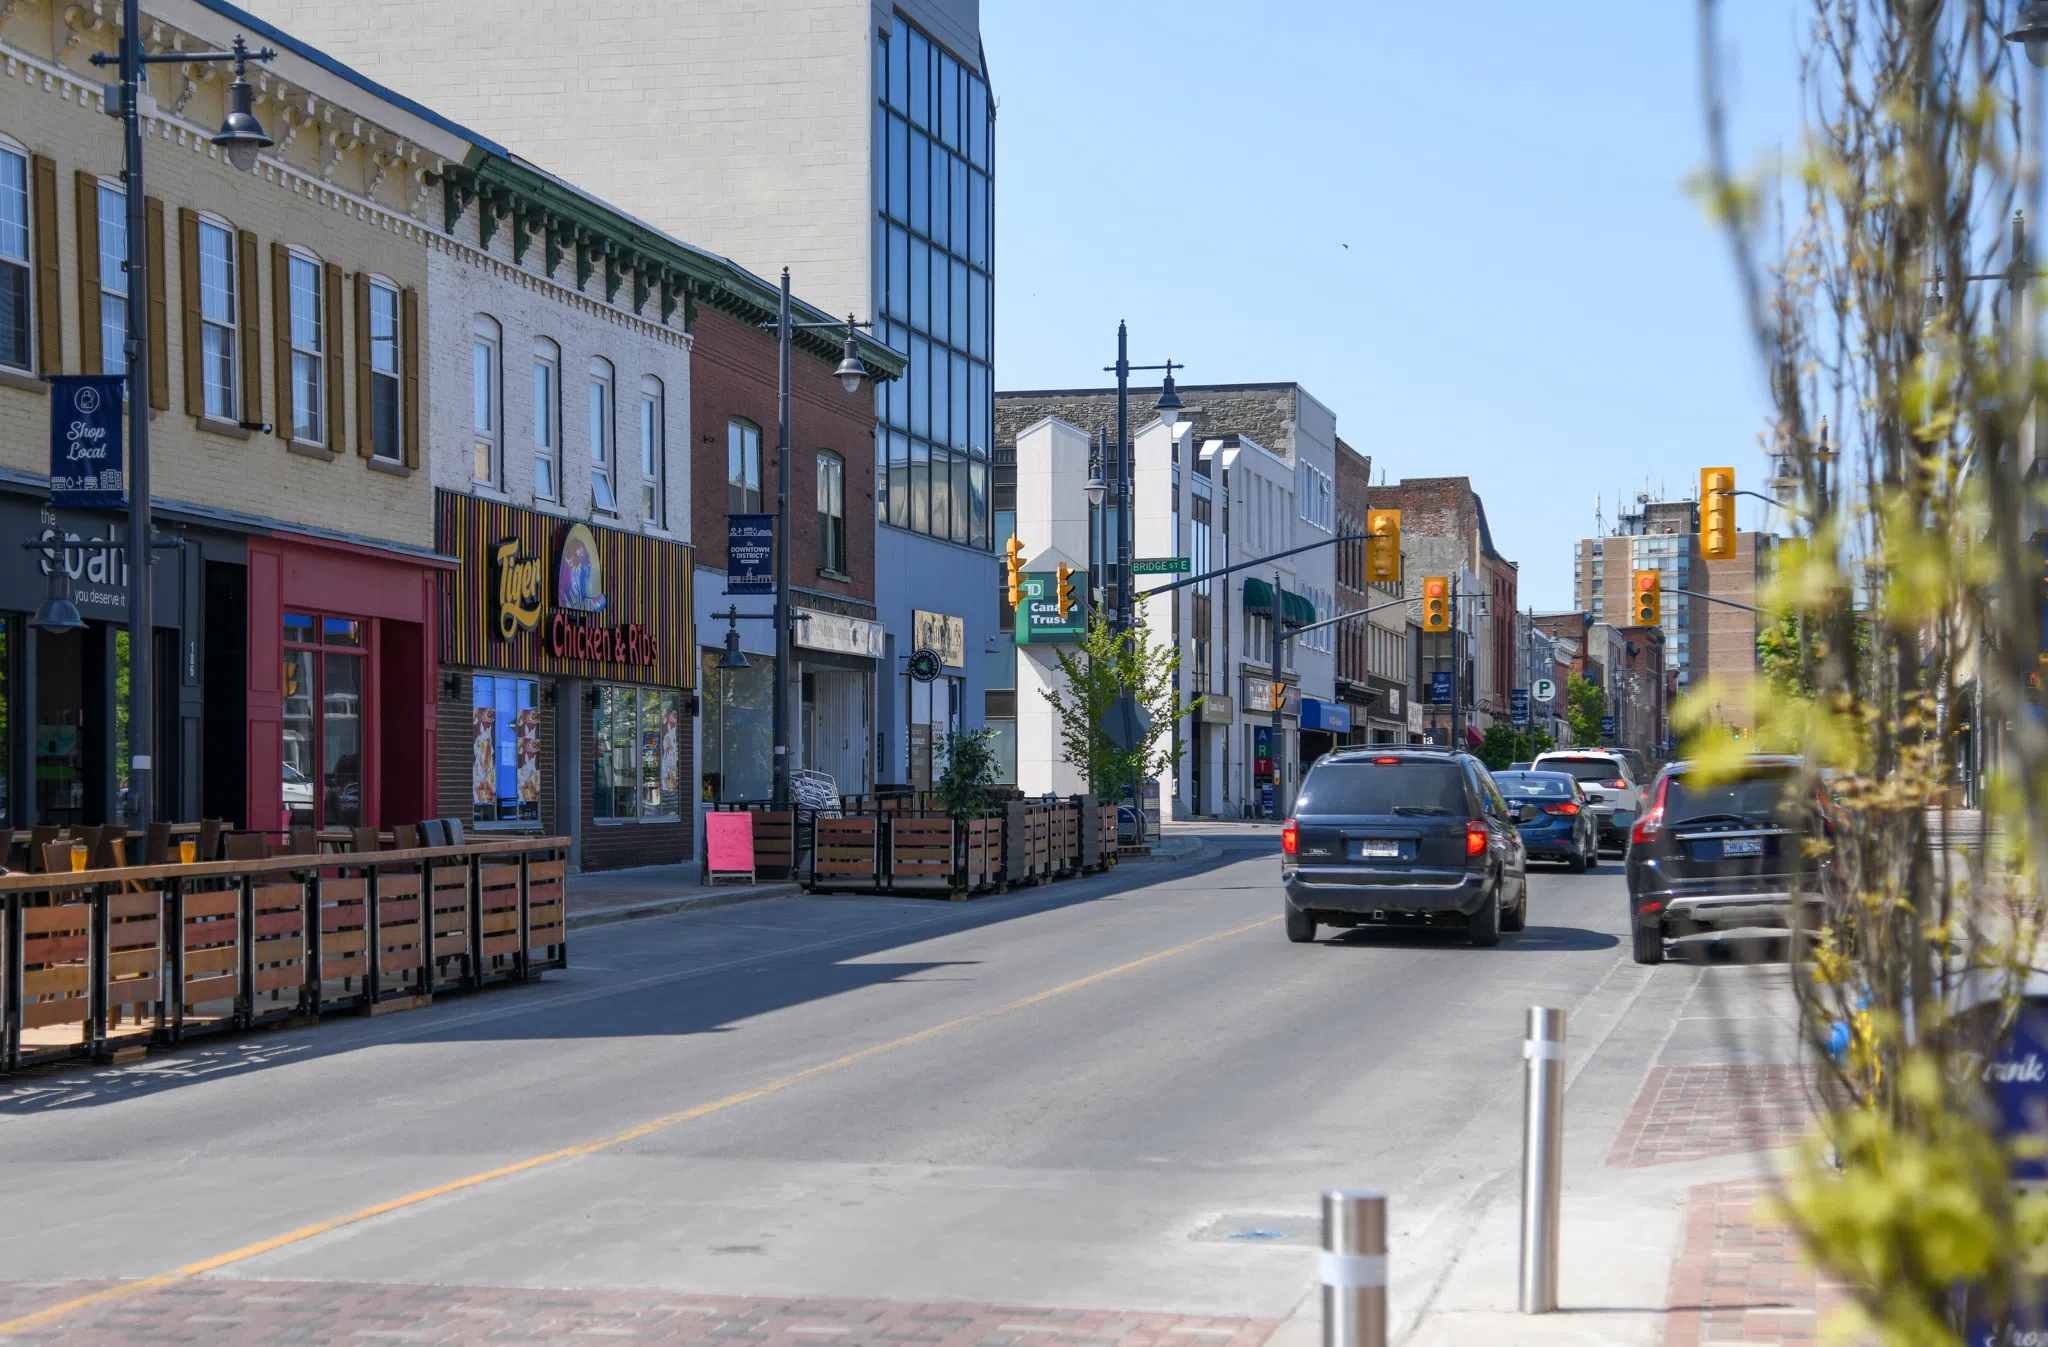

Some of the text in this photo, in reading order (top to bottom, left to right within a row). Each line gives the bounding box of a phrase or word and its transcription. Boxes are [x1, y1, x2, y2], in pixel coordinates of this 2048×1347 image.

[66, 421, 106, 442] Shop
[66, 441, 107, 460] Local
[41, 507, 56, 525] the
[1133, 561, 1168, 572] BRIDGE
[1181, 560, 1188, 570] E
[75, 588, 126, 607] you deserve it
[497, 537, 542, 641] Tiger
[1024, 583, 1042, 596] TD
[1030, 602, 1078, 612] Cana
[553, 612, 659, 666] Chicken & Ribs
[1538, 681, 1551, 695] P
[1258, 729, 1268, 772] ART
[1704, 823, 1779, 832] VOLVO
